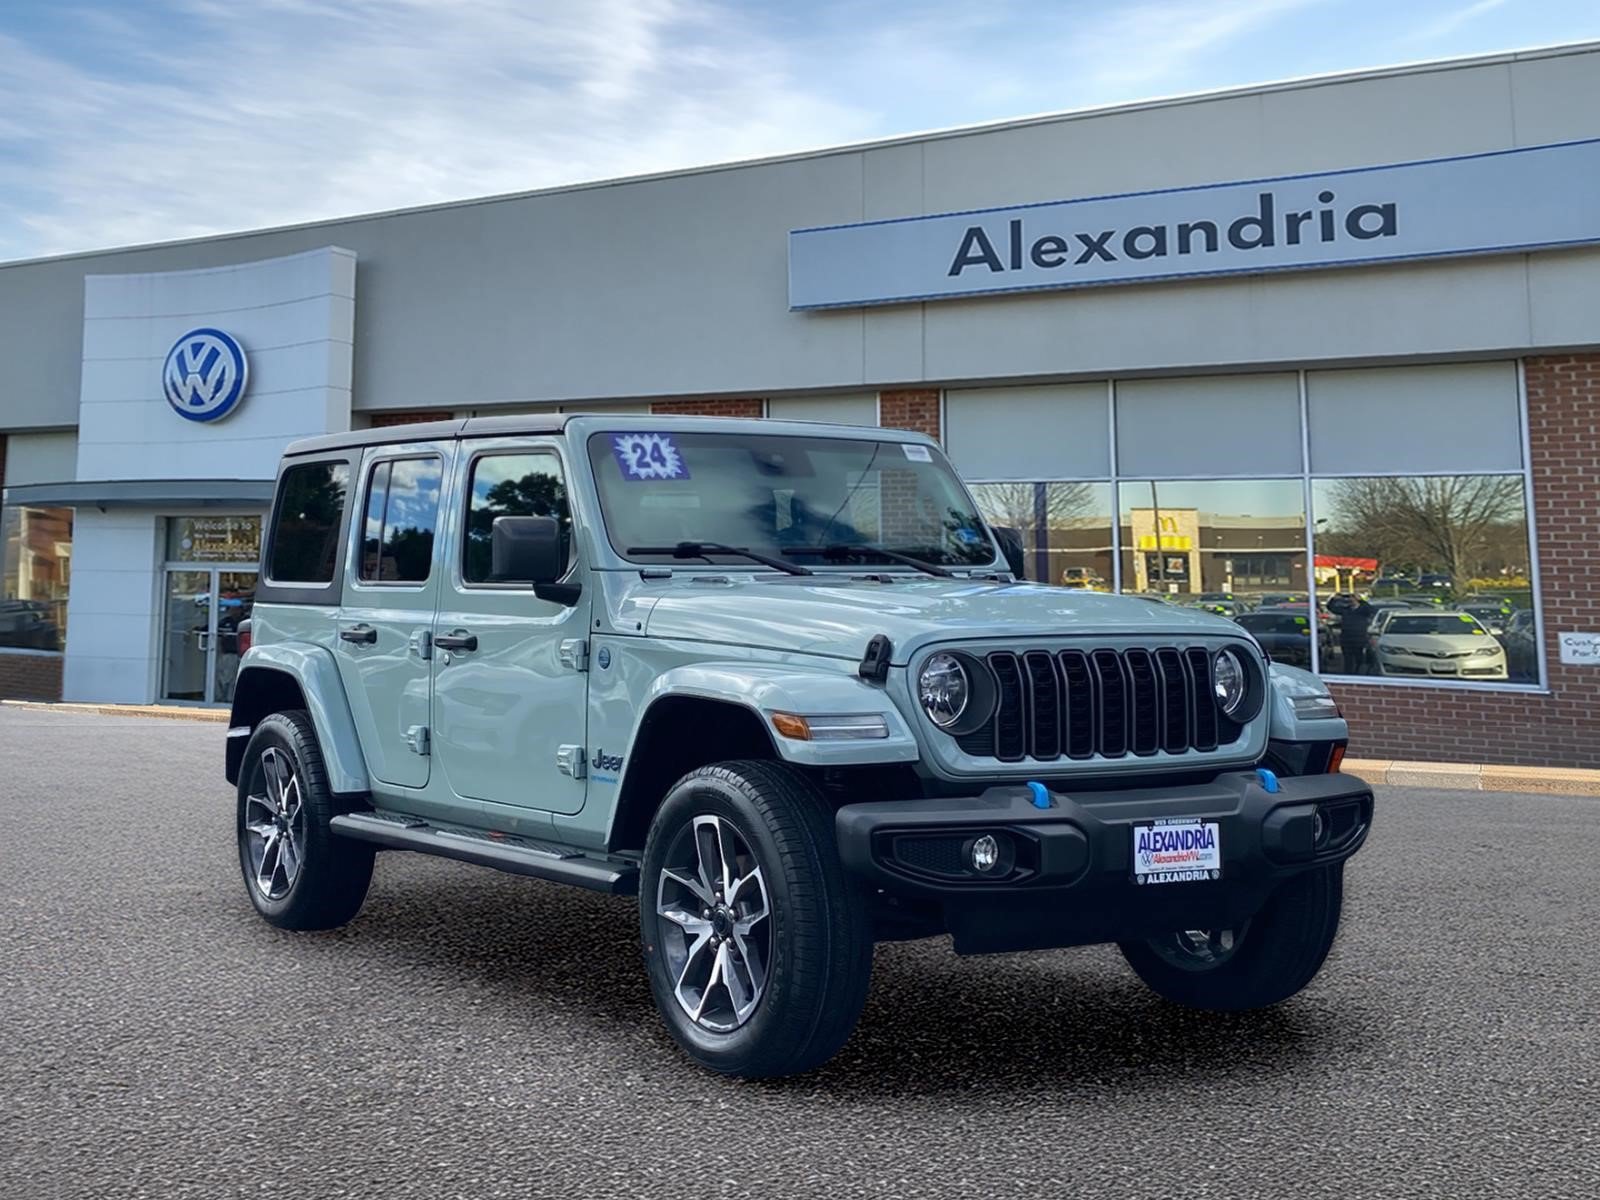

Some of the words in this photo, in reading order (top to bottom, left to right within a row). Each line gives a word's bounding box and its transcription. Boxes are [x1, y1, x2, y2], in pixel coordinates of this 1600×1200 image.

[947, 190, 1398, 277] Alexandria
[165, 331, 241, 417] VW
[631, 442, 667, 468] 24
[193, 521, 239, 530] Welcome
[1138, 828, 1215, 853] ALEXANDRIA
[1146, 870, 1210, 884] ALEXANDRIA
